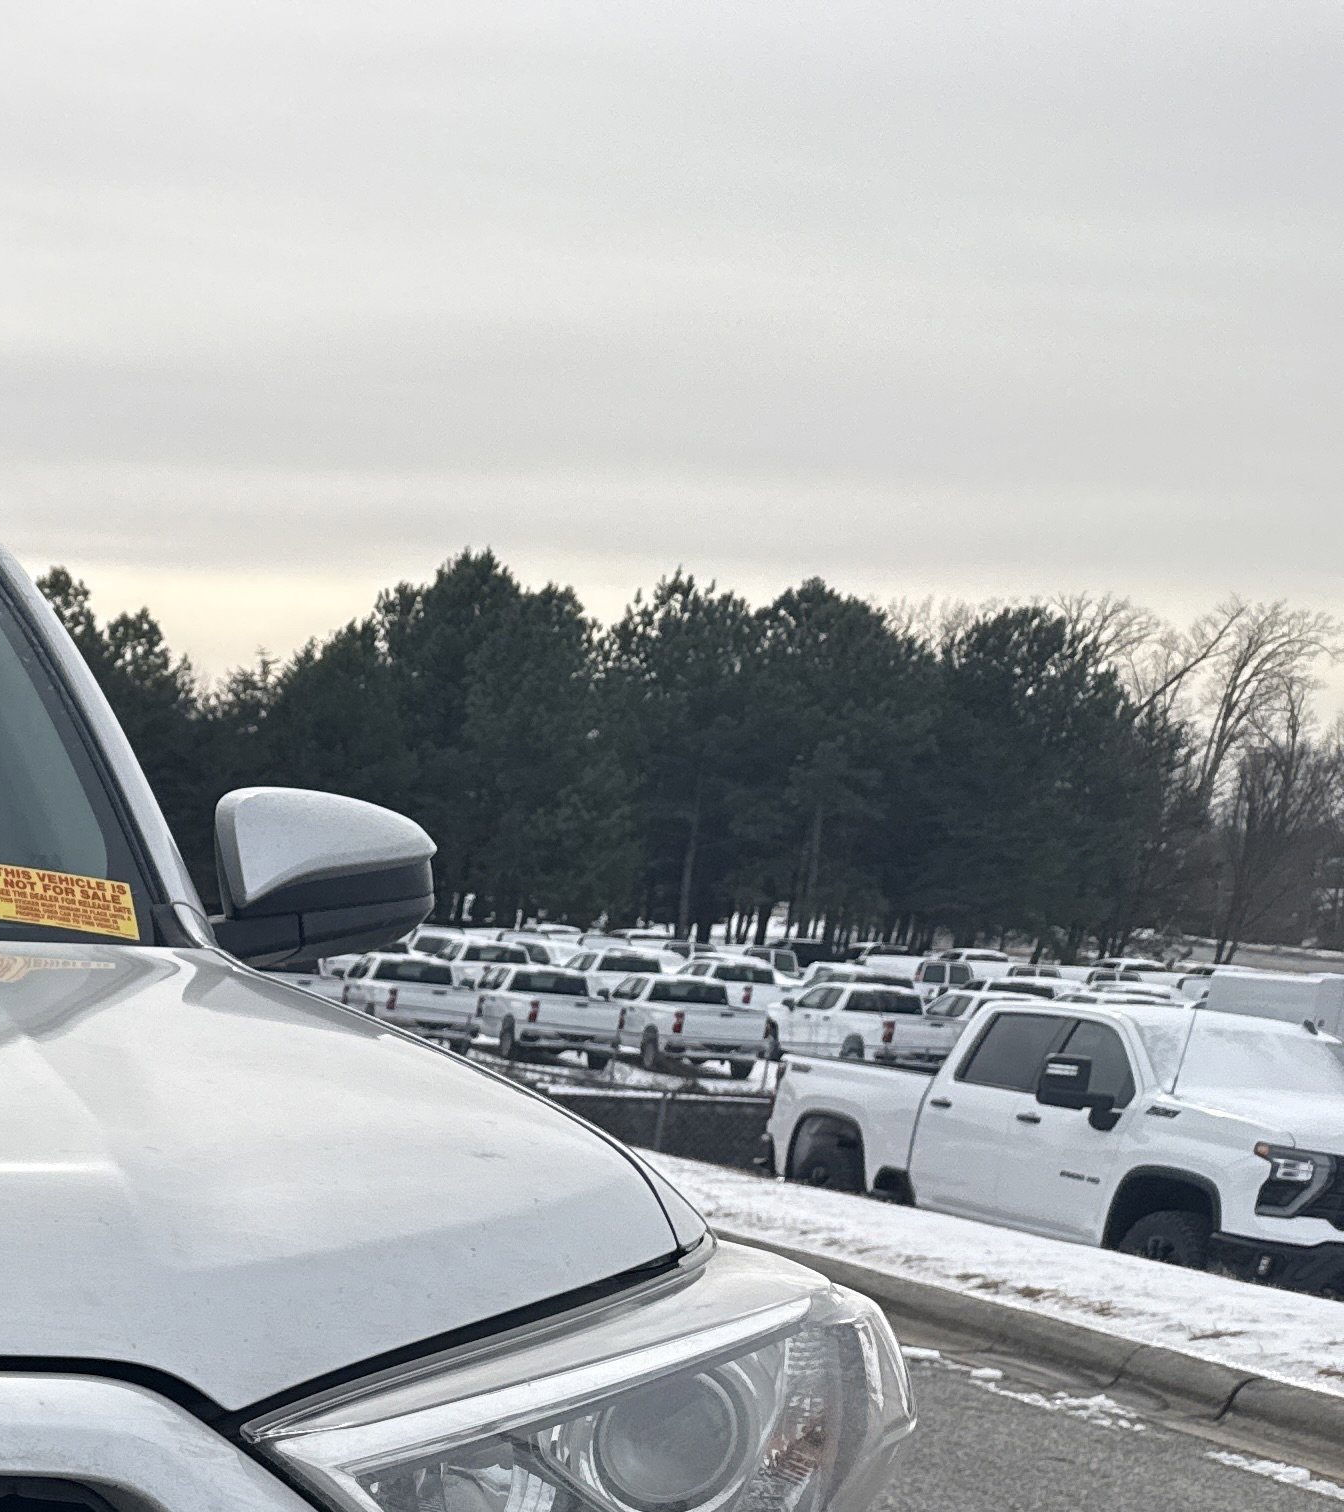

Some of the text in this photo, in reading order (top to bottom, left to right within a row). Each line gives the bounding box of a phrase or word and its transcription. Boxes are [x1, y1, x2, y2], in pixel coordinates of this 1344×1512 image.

[3, 878, 121, 904] NOT FOR SALE
[36, 873, 106, 890] VEHICLE
[111, 884, 126, 894] IS
[12, 889, 27, 898] THE
[29, 892, 58, 903] DEALER
[60, 897, 75, 905] FOR
[78, 899, 111, 910] RELEASE
[112, 904, 131, 914] DATE
